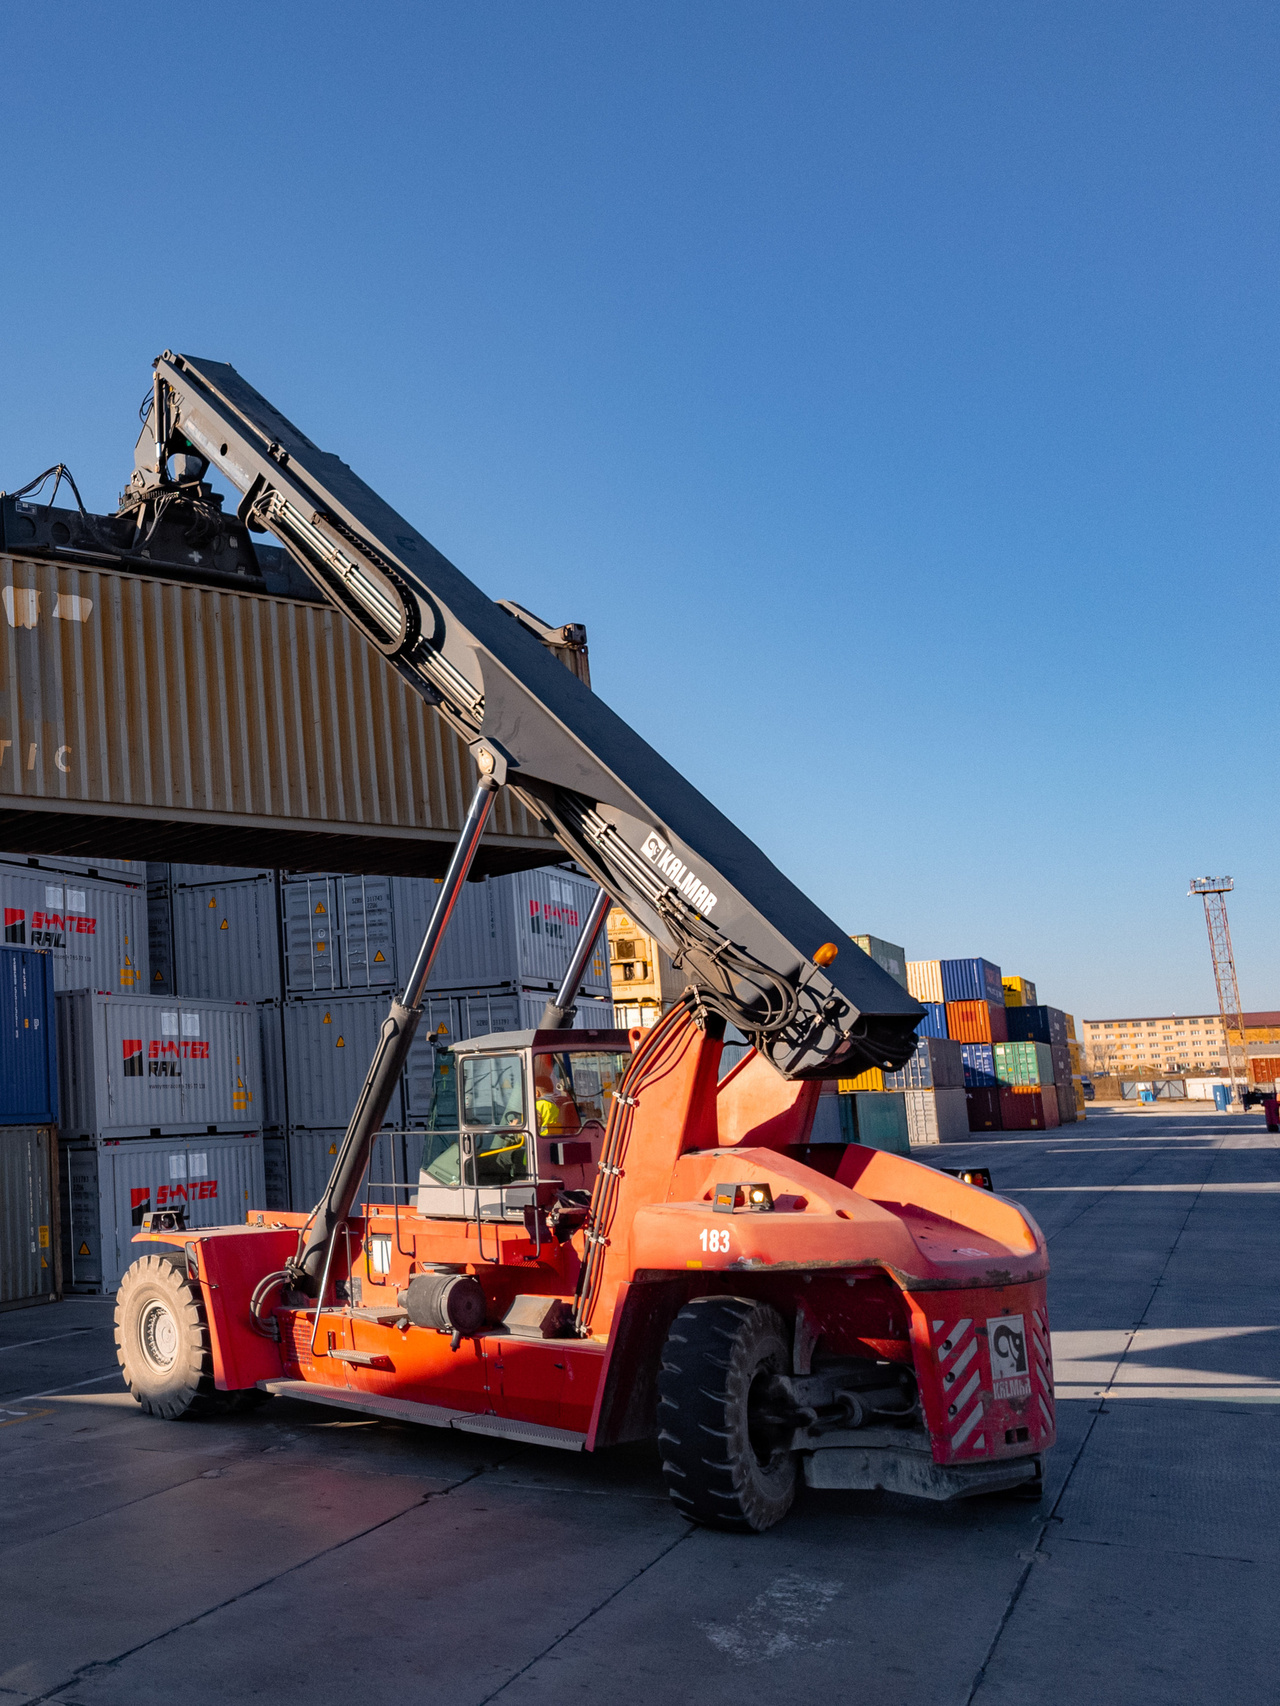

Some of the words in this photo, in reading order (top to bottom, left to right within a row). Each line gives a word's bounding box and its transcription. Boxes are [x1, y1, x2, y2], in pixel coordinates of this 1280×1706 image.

[657, 848, 718, 917] KALMAR
[31, 911, 97, 934] SYNTEZ
[31, 930, 66, 948] RAIL
[148, 1040, 209, 1059] SYNTEZ
[148, 1061, 181, 1077] RAIL
[157, 1180, 218, 1205] SYNTEZ
[699, 1228, 730, 1253] 183
[993, 1377, 1032, 1400] KALMAR
